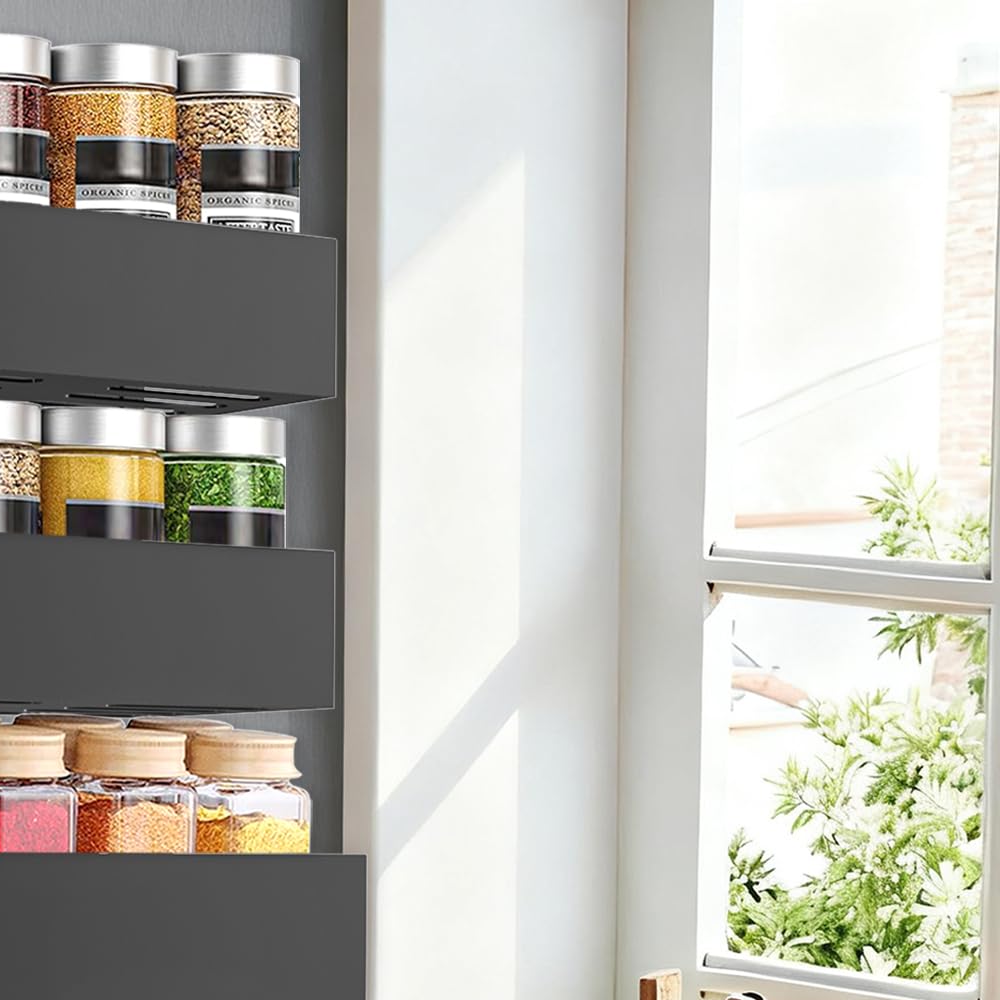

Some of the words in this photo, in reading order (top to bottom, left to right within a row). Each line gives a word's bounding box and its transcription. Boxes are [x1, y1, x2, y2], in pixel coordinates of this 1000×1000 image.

[12, 182, 44, 192] SPICES
[81, 188, 137, 197] ORGANIC
[141, 190, 170, 200] SPICES
[207, 196, 262, 205] ORGANIC
[265, 197, 295, 207] SPICES
